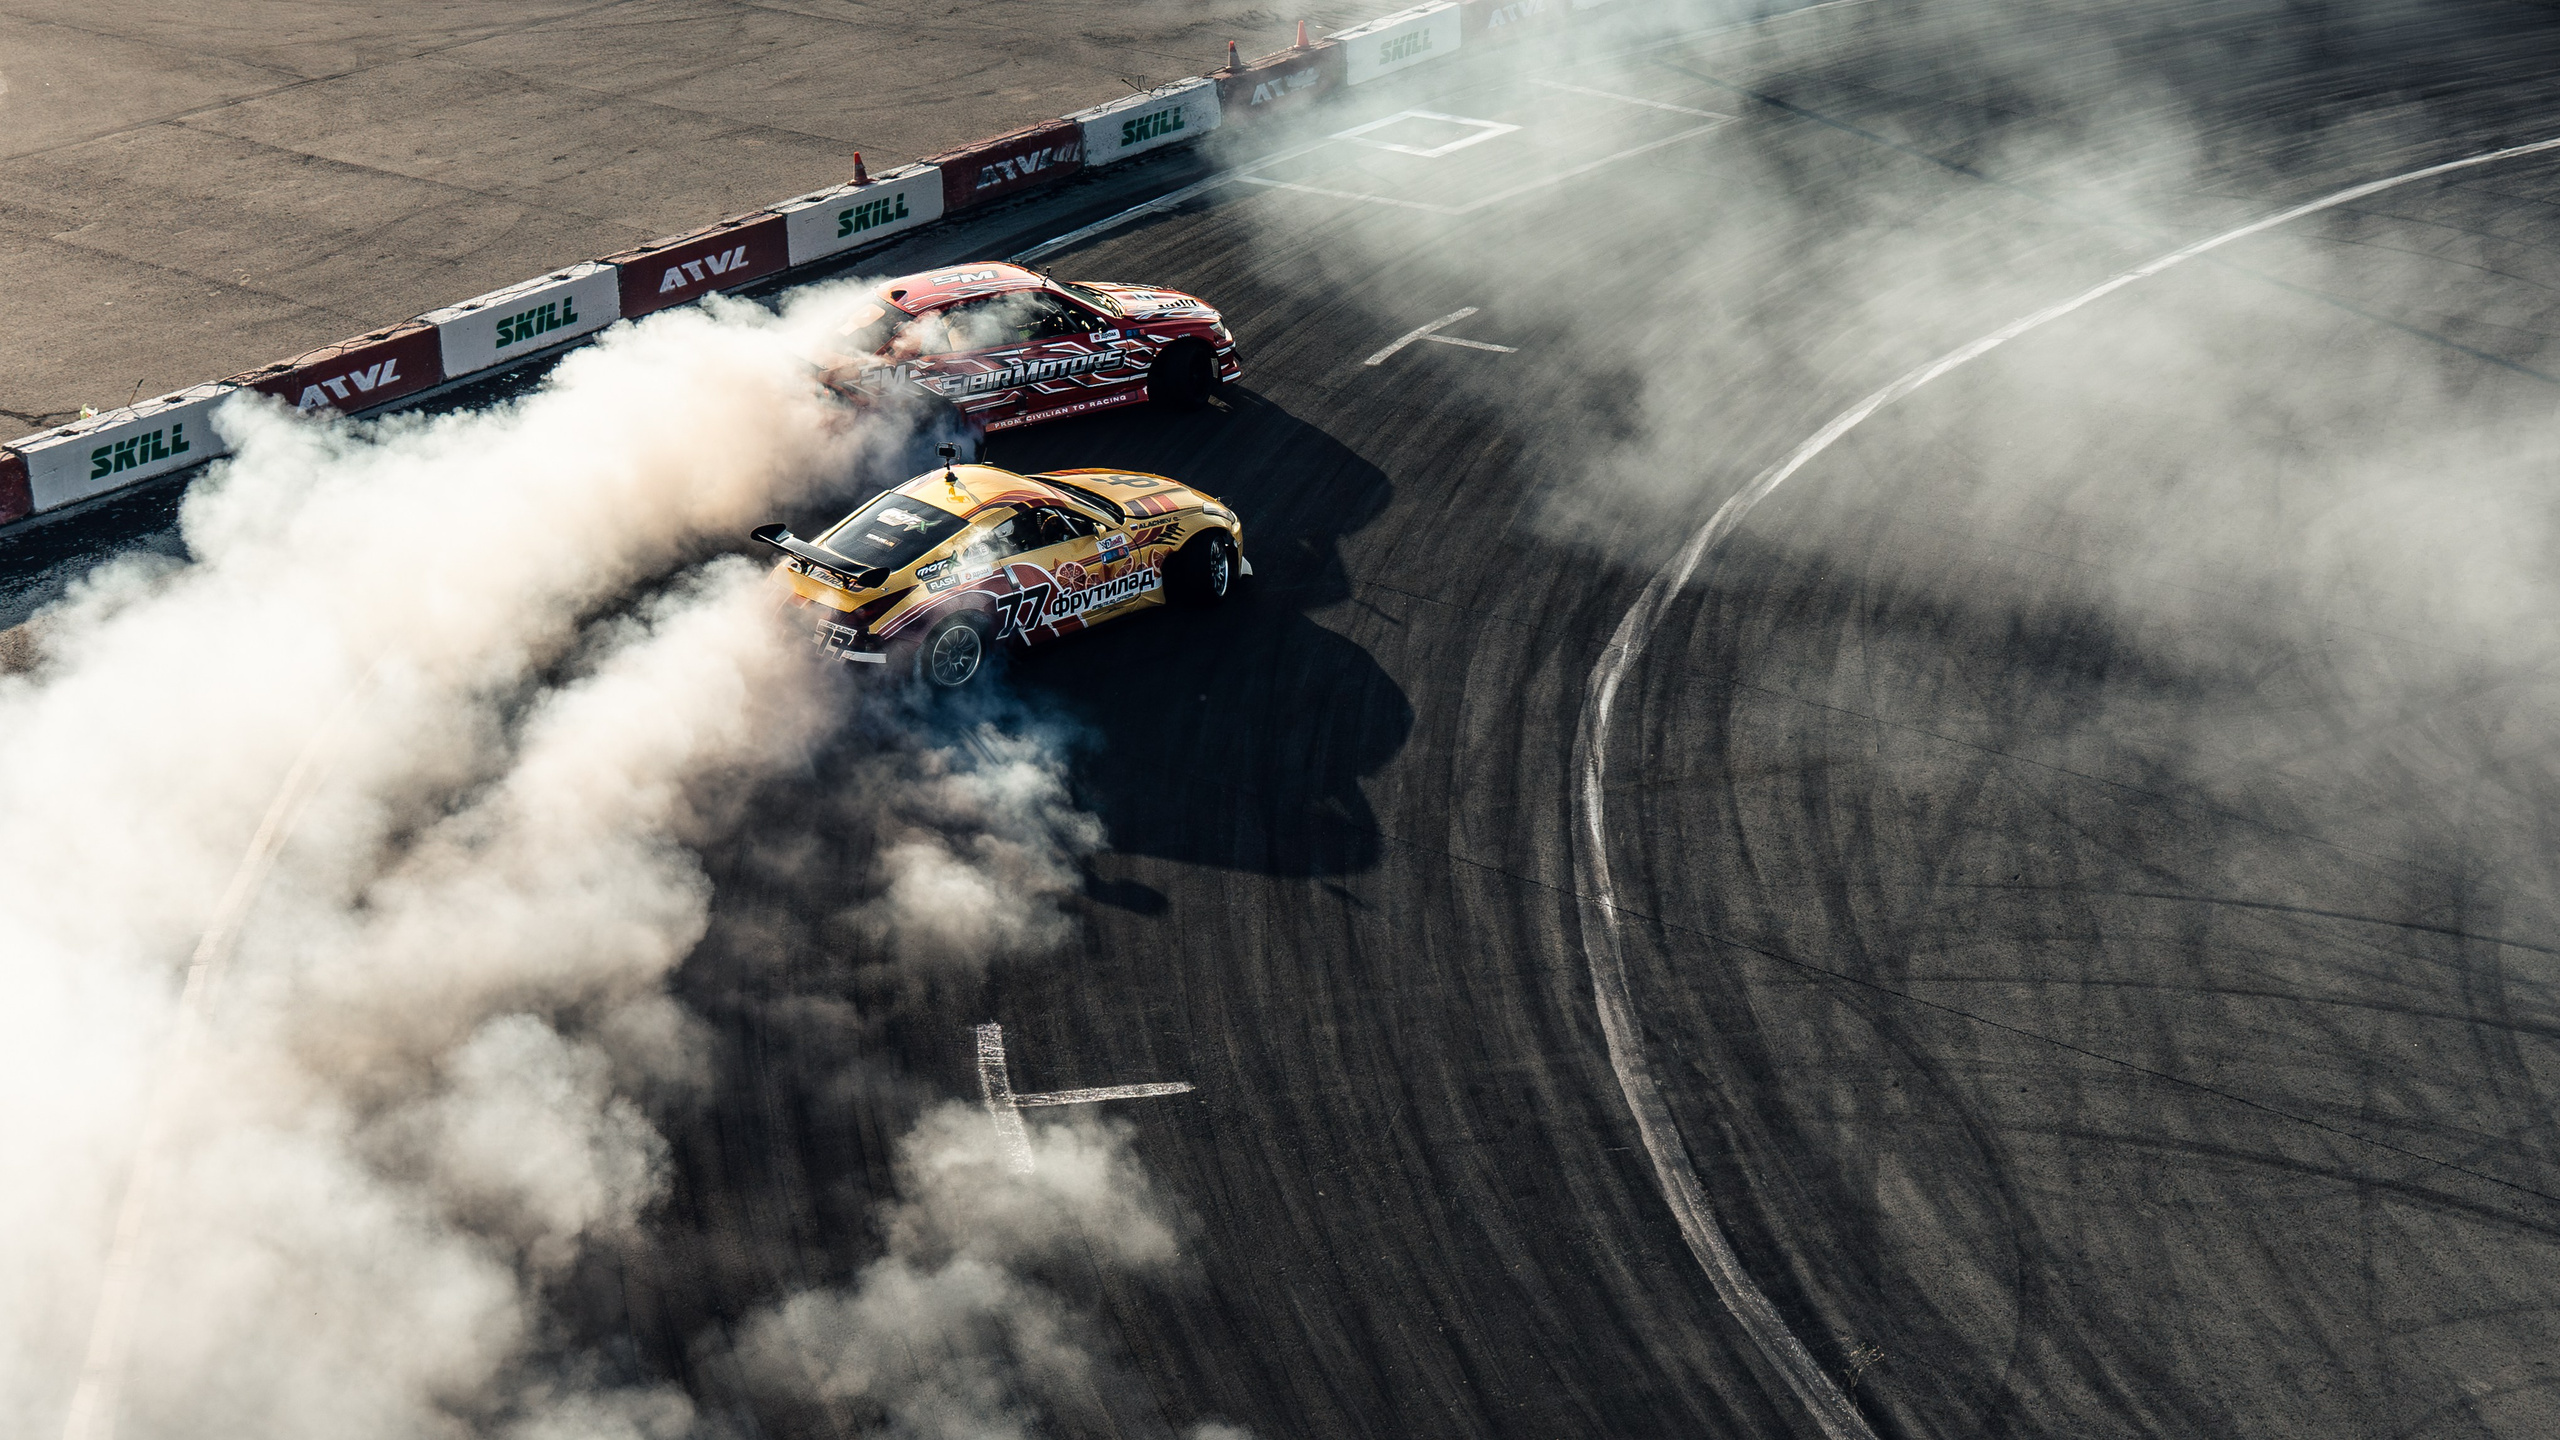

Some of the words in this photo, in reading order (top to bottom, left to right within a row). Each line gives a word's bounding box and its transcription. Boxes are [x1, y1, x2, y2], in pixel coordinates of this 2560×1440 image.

[1379, 28, 1433, 65] SKILL
[1121, 107, 1185, 147] SKILL
[838, 192, 909, 239] SKILL
[659, 245, 749, 293] ATVL
[929, 270, 999, 286] SM
[496, 296, 579, 349] SKILL
[1025, 407, 1069, 422] CIVILIAN
[1089, 395, 1126, 407] RACING
[91, 423, 190, 481] SKILL
[930, 577, 956, 590] FLASH
[1052, 570, 1154, 617] фрутилад
[996, 583, 1051, 640] 77
